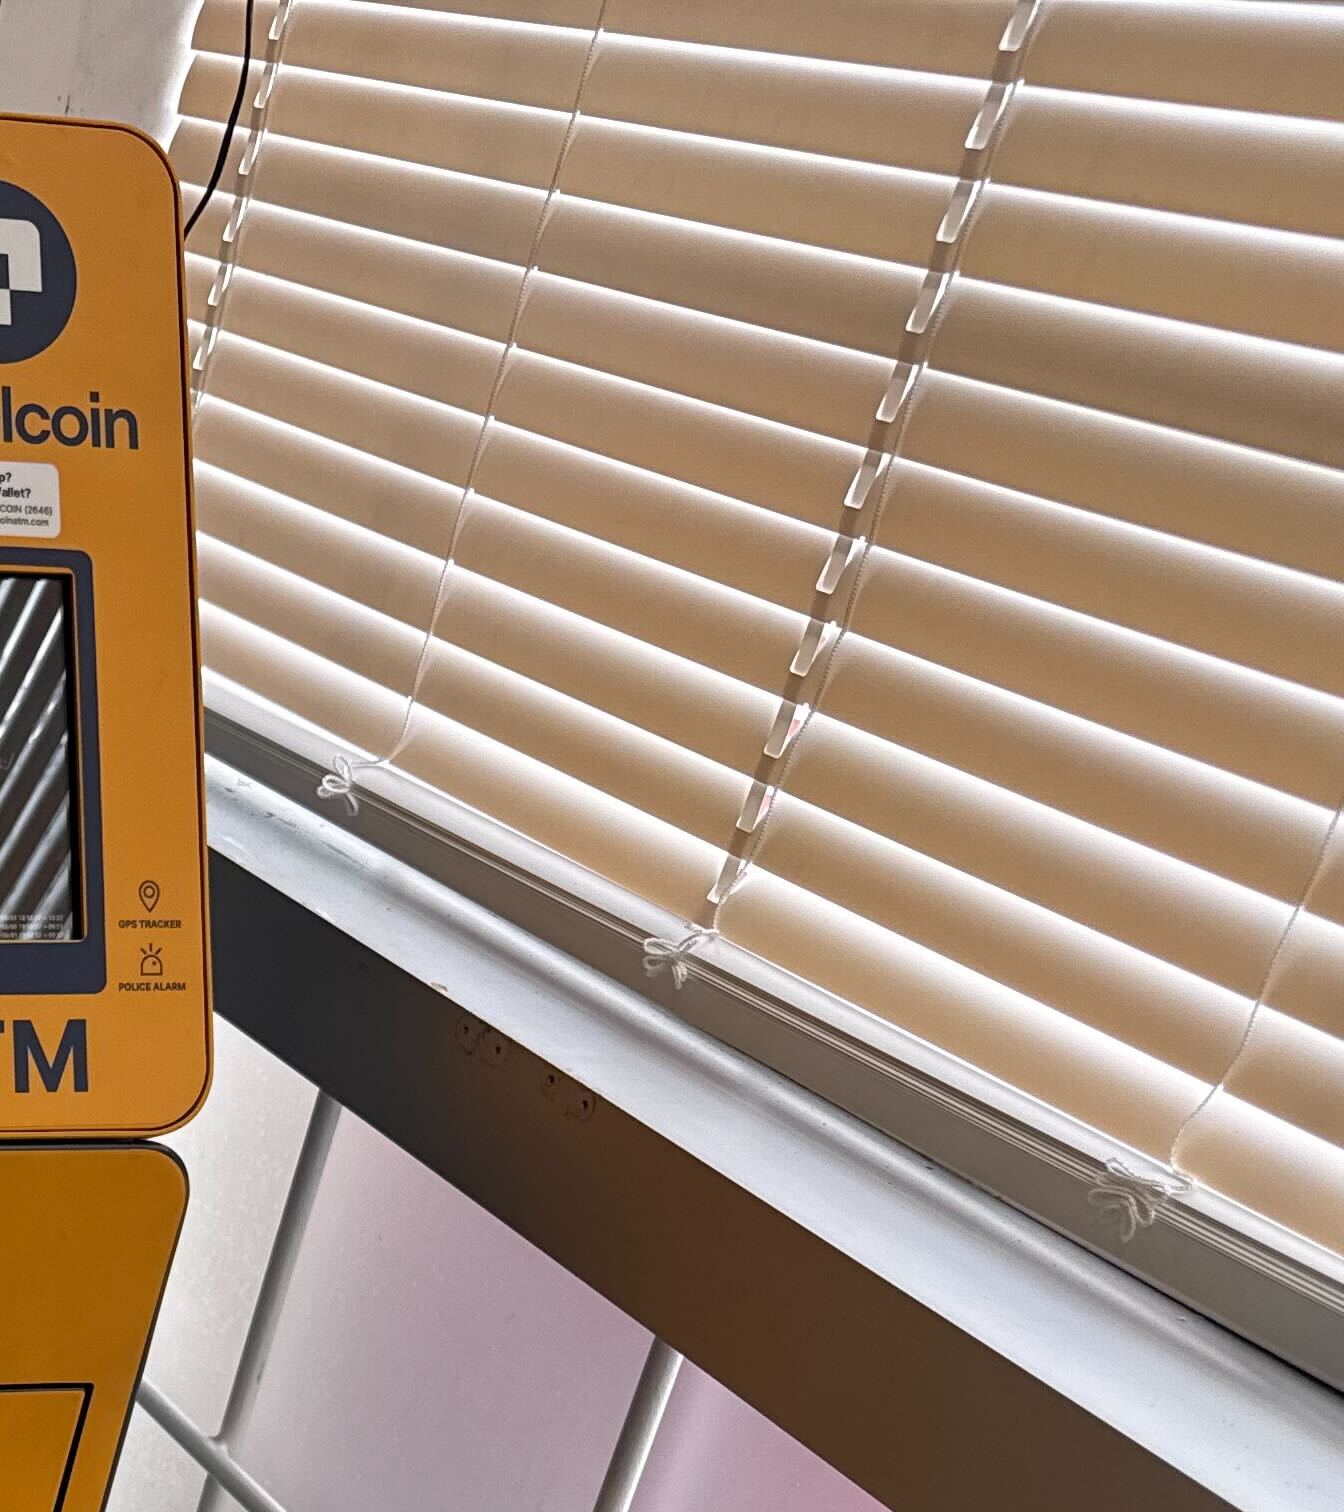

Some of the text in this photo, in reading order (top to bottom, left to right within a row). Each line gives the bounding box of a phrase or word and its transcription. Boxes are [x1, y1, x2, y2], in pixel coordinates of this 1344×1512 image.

[25, 505, 53, 516] (2646)
[118, 919, 181, 929] GPS TRACKER
[118, 982, 187, 992] POLICE ALARM
